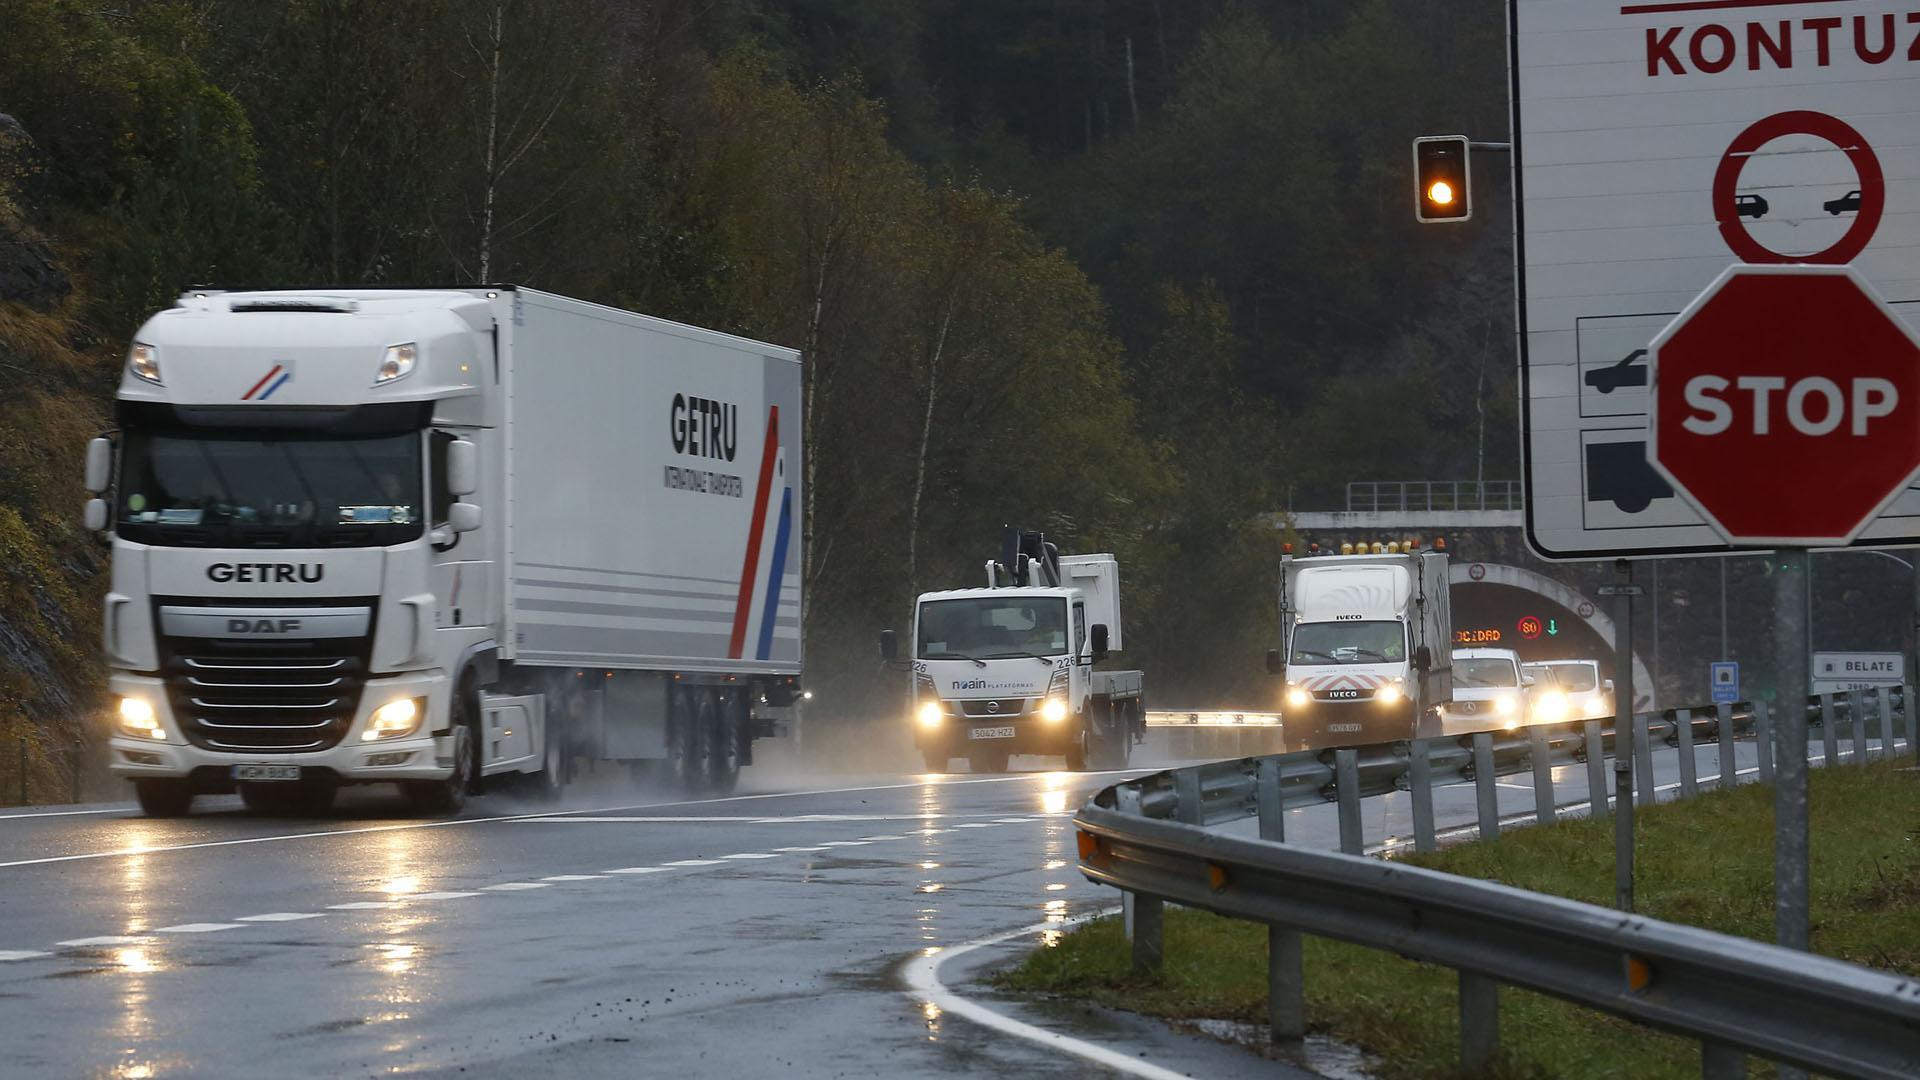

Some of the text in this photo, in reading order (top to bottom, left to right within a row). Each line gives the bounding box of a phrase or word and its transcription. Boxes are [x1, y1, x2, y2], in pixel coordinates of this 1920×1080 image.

[1681, 374, 1899, 437] STOP
[671, 392, 737, 462] GETRU
[207, 562, 324, 583] GETRU
[228, 619, 301, 634] DAF
[1522, 622, 1538, 634] 80
[1057, 656, 1076, 669] 226
[1846, 661, 1894, 672] BELATE
[1329, 690, 1357, 698] IVECO
